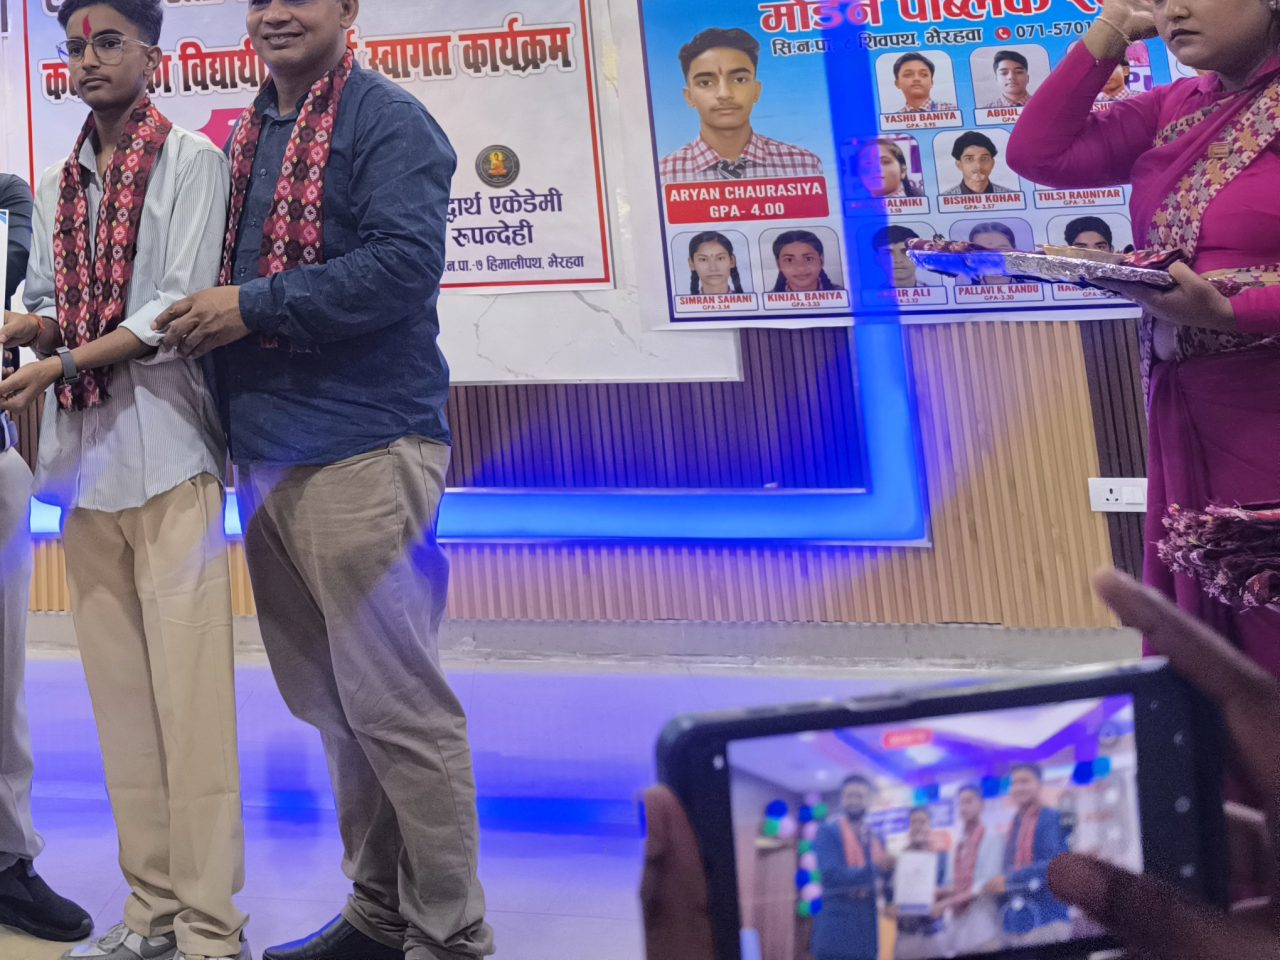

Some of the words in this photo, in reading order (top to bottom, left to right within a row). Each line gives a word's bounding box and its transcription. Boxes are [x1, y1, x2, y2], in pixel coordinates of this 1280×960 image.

[925, 27, 983, 45] भैरहवा
[1016, 21, 1092, 38] 071-5701
[365, 34, 452, 79] स्वागत
[458, 17, 572, 73] कार्यक्रम
[884, 113, 917, 123] YASHU
[919, 111, 957, 122] BANIYA
[987, 107, 1020, 118] ABDUL
[670, 187, 720, 202] ARYAN
[724, 182, 823, 200] CHAURASIYA
[943, 194, 982, 205] BISHNU
[985, 192, 1021, 203] KOHAR
[1038, 191, 1066, 201] TULSI
[1069, 189, 1121, 200] RAUNIYAR
[489, 187, 563, 215] एकेडेमी
[883, 198, 922, 207] ALMIKI
[709, 204, 746, 218] GPA-
[750, 202, 785, 216] 4.00
[452, 219, 534, 247] रूपन्देही
[548, 253, 585, 269] भैरहवा
[767, 292, 802, 302] KINJAL
[804, 291, 843, 301] BANIYA
[913, 288, 931, 297] ALI
[958, 285, 995, 296] PALLAVI
[997, 285, 1007, 294] K.
[679, 295, 716, 305] SIMRAN
[718, 294, 753, 304] SAHANI
